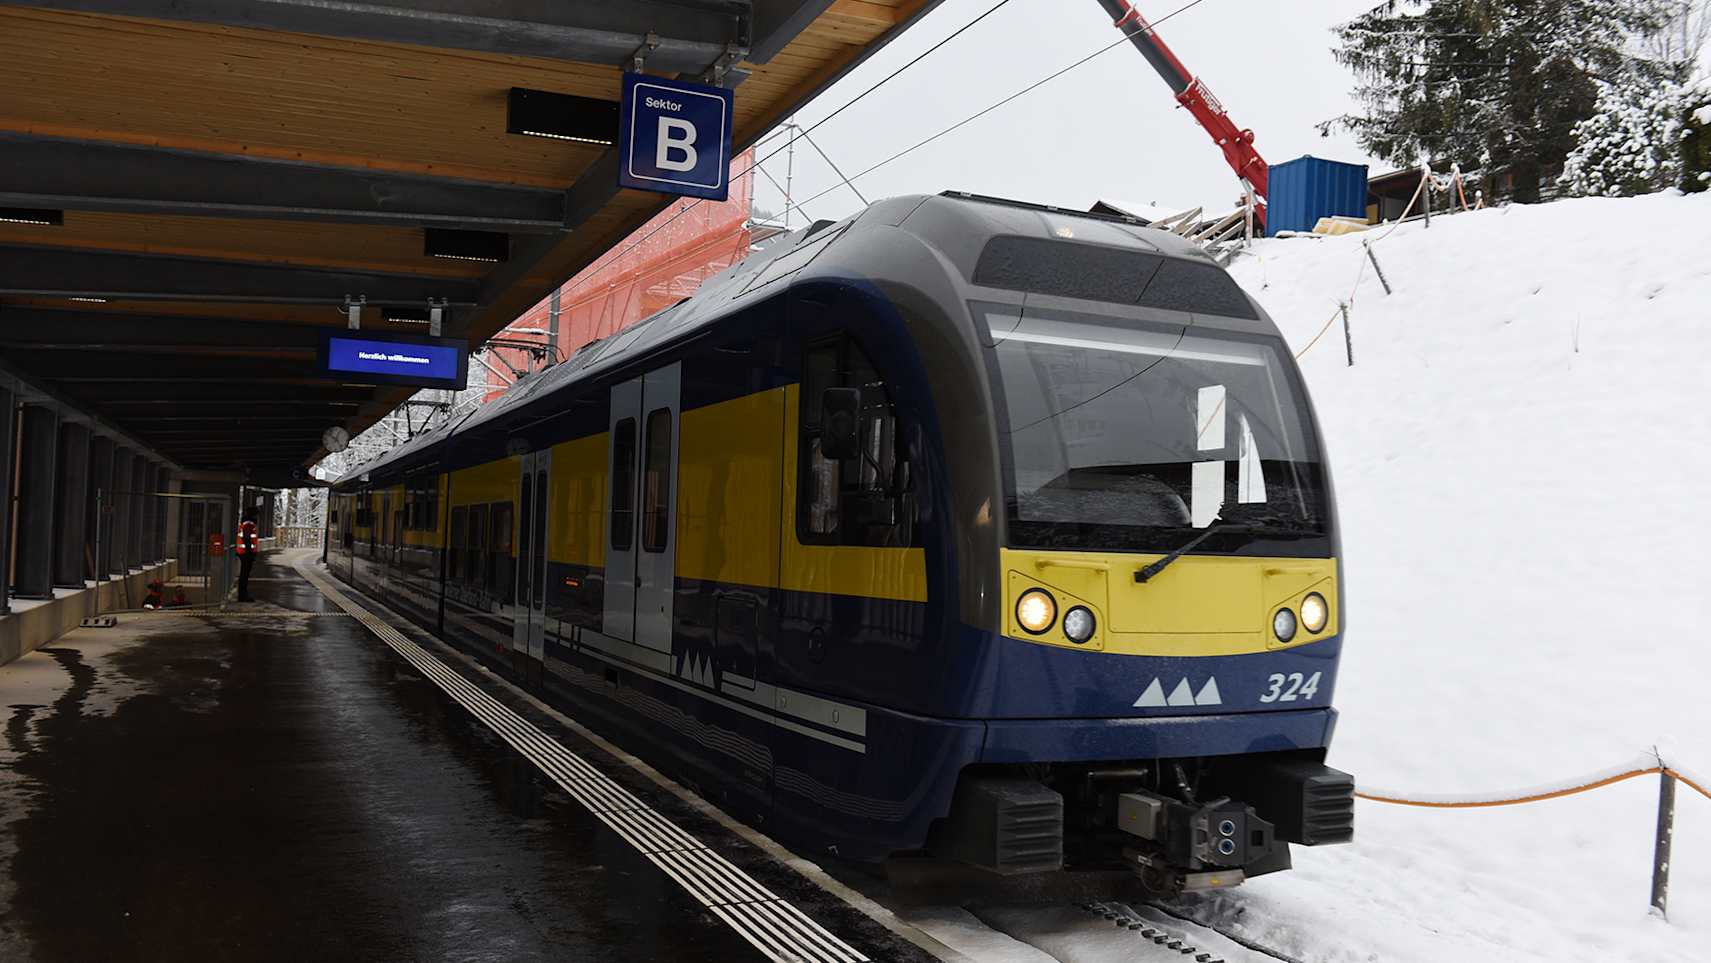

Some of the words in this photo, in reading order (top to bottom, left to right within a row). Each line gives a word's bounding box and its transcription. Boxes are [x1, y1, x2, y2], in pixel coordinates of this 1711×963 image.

[645, 97, 682, 111] Sektor
[656, 116, 697, 172] B
[359, 351, 387, 360] Herzlich
[388, 354, 429, 363] willkommen
[1260, 671, 1322, 702] 324
